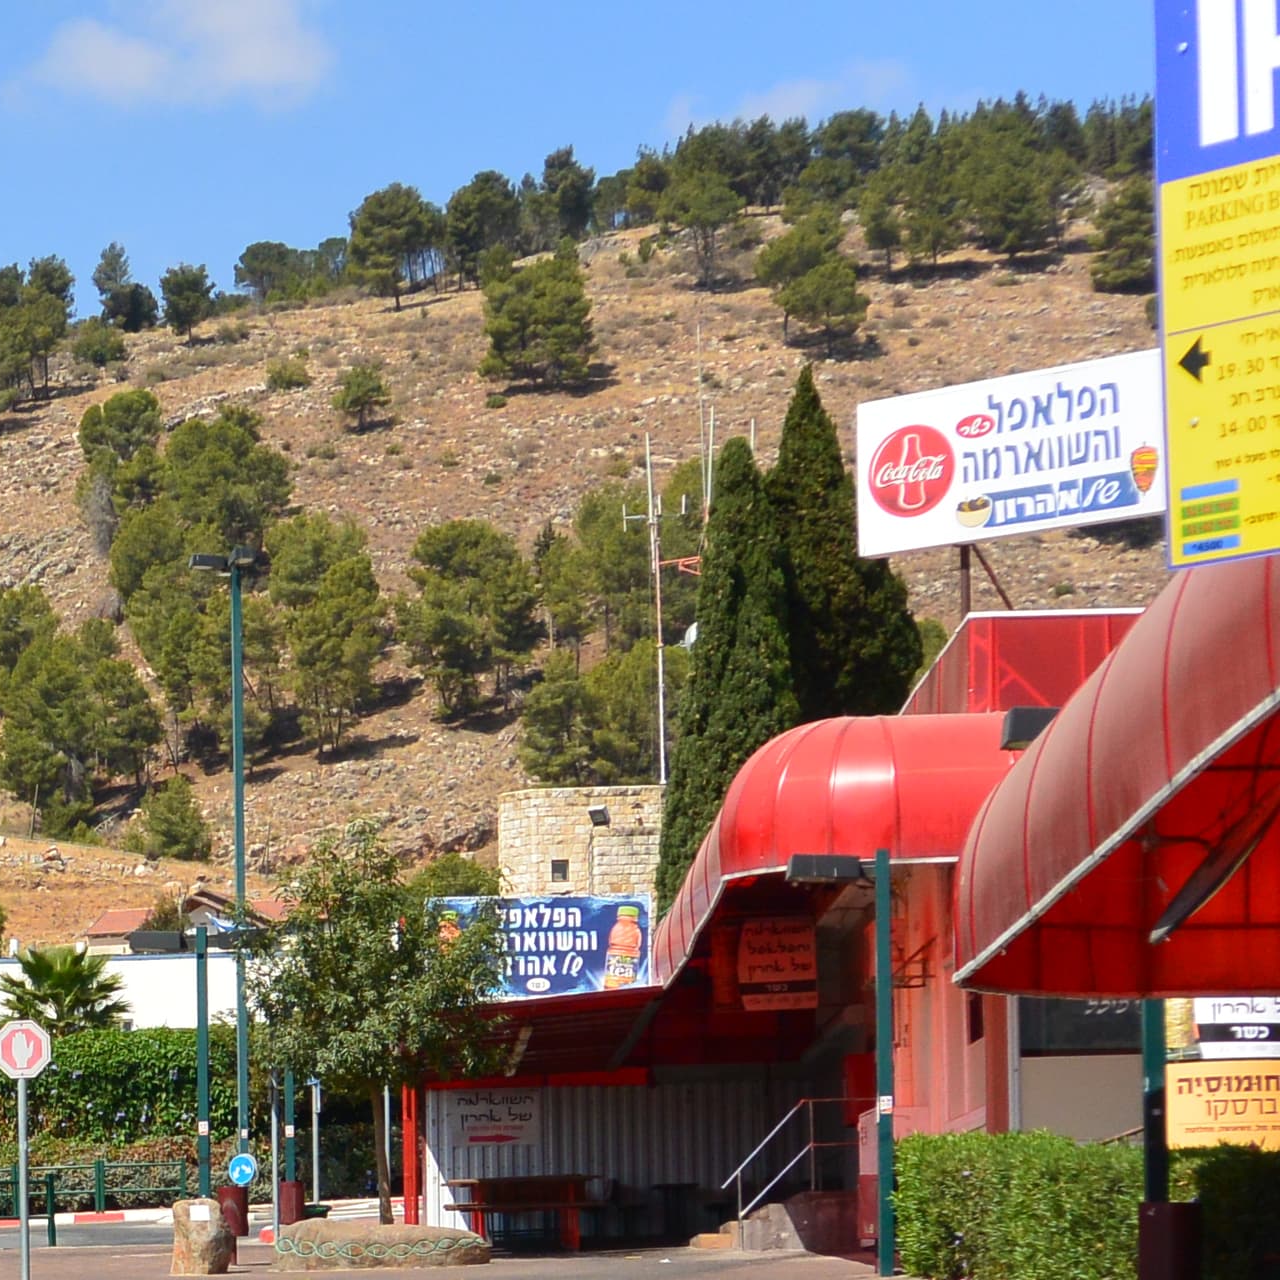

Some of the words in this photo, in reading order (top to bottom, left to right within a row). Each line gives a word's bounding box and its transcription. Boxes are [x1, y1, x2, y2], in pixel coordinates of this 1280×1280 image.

[1190, 172, 1248, 199] שמונה
[1187, 193, 1264, 231] PARKING
[988, 382, 1120, 434] הפלאפל
[960, 418, 990, 435] כשר
[962, 426, 1121, 483] והשווארמה
[875, 454, 947, 488] Coca-Cola
[994, 487, 1079, 523] אהרון
[1083, 479, 1121, 507] של
[562, 952, 584, 977] של
[1212, 998, 1267, 1022] אהרון
[1230, 1026, 1269, 1039] כשר
[461, 1109, 502, 1131] אהרון
[508, 1107, 532, 1122] של
[1206, 1098, 1278, 1120] ברסקו
